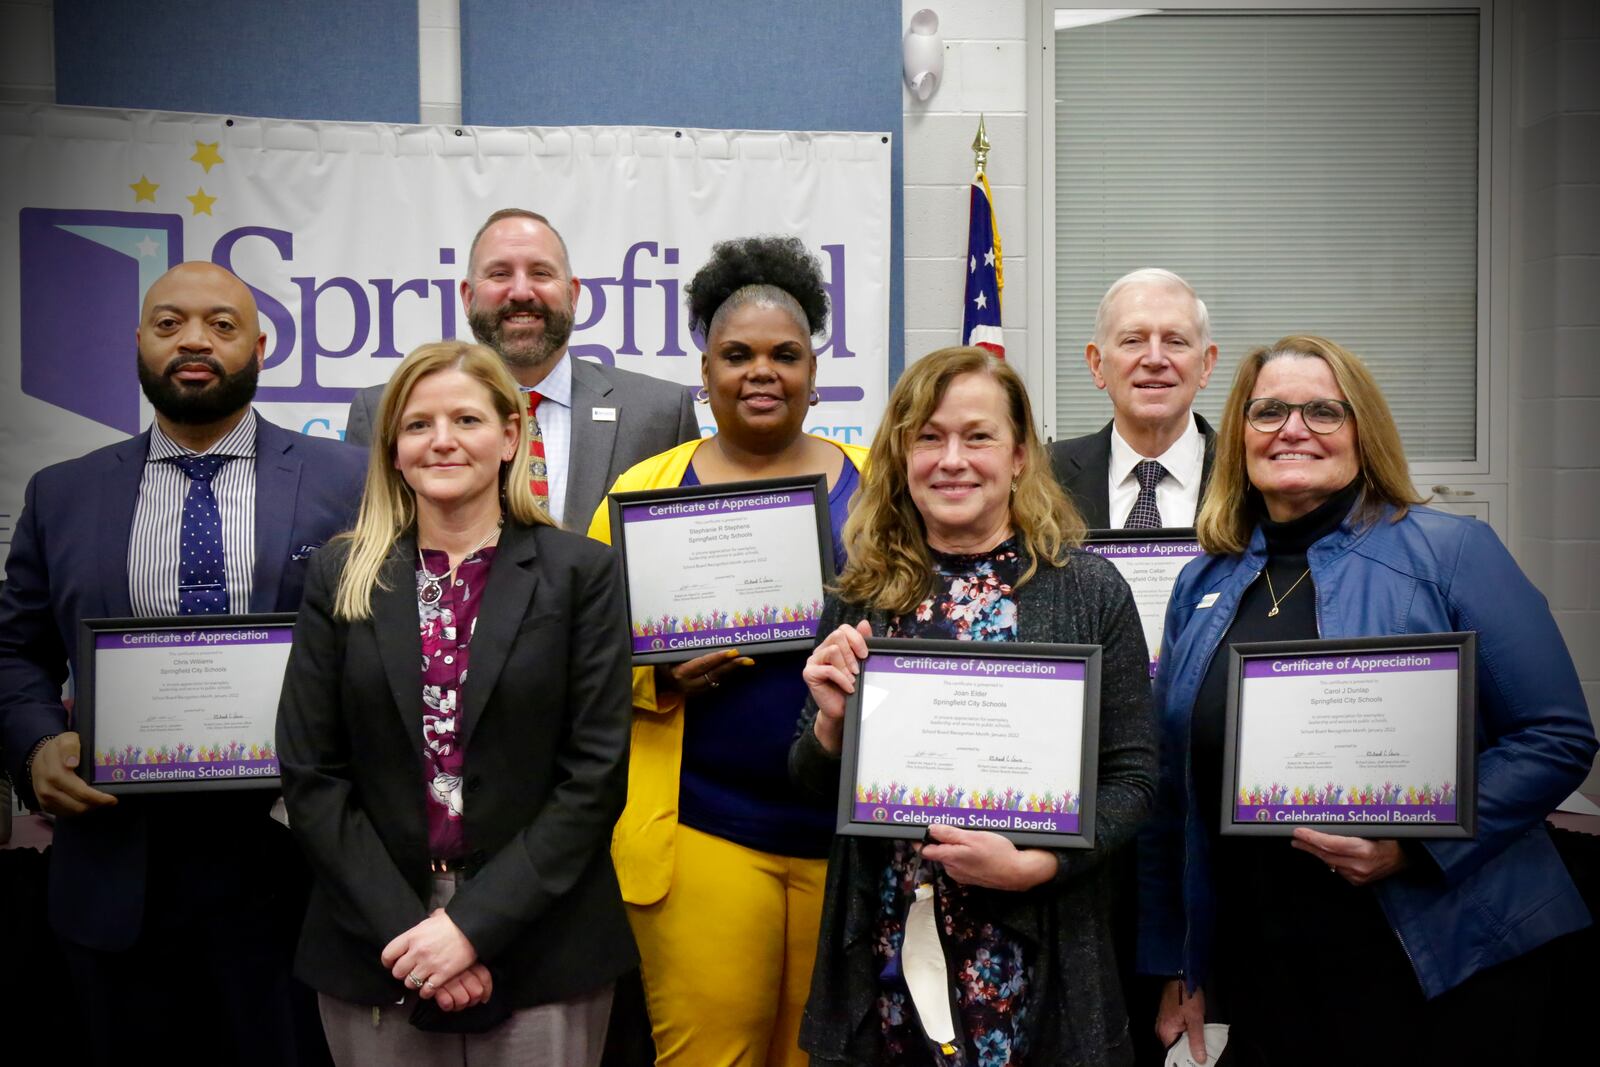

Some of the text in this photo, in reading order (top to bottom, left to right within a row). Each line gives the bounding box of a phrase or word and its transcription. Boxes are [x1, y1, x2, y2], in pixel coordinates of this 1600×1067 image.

[649, 494, 790, 516] Certificate of Appreciation
[688, 535, 717, 543] Springfield
[1086, 544, 1137, 554] Certificate
[1140, 544, 1150, 553] of
[122, 630, 268, 644] Certificate of Appreciation
[670, 626, 810, 650] Celebrating School Boards
[894, 657, 1056, 676] Certificate of Appreciation
[1272, 656, 1431, 673] Certificate of Appreciation
[933, 698, 966, 707] Springfield
[1310, 697, 1342, 706] Springfield
[131, 764, 276, 780] Celebrating School Boards
[893, 810, 1057, 831] Celebrating School Boards
[1275, 810, 1436, 822] Celebrating School Boards
